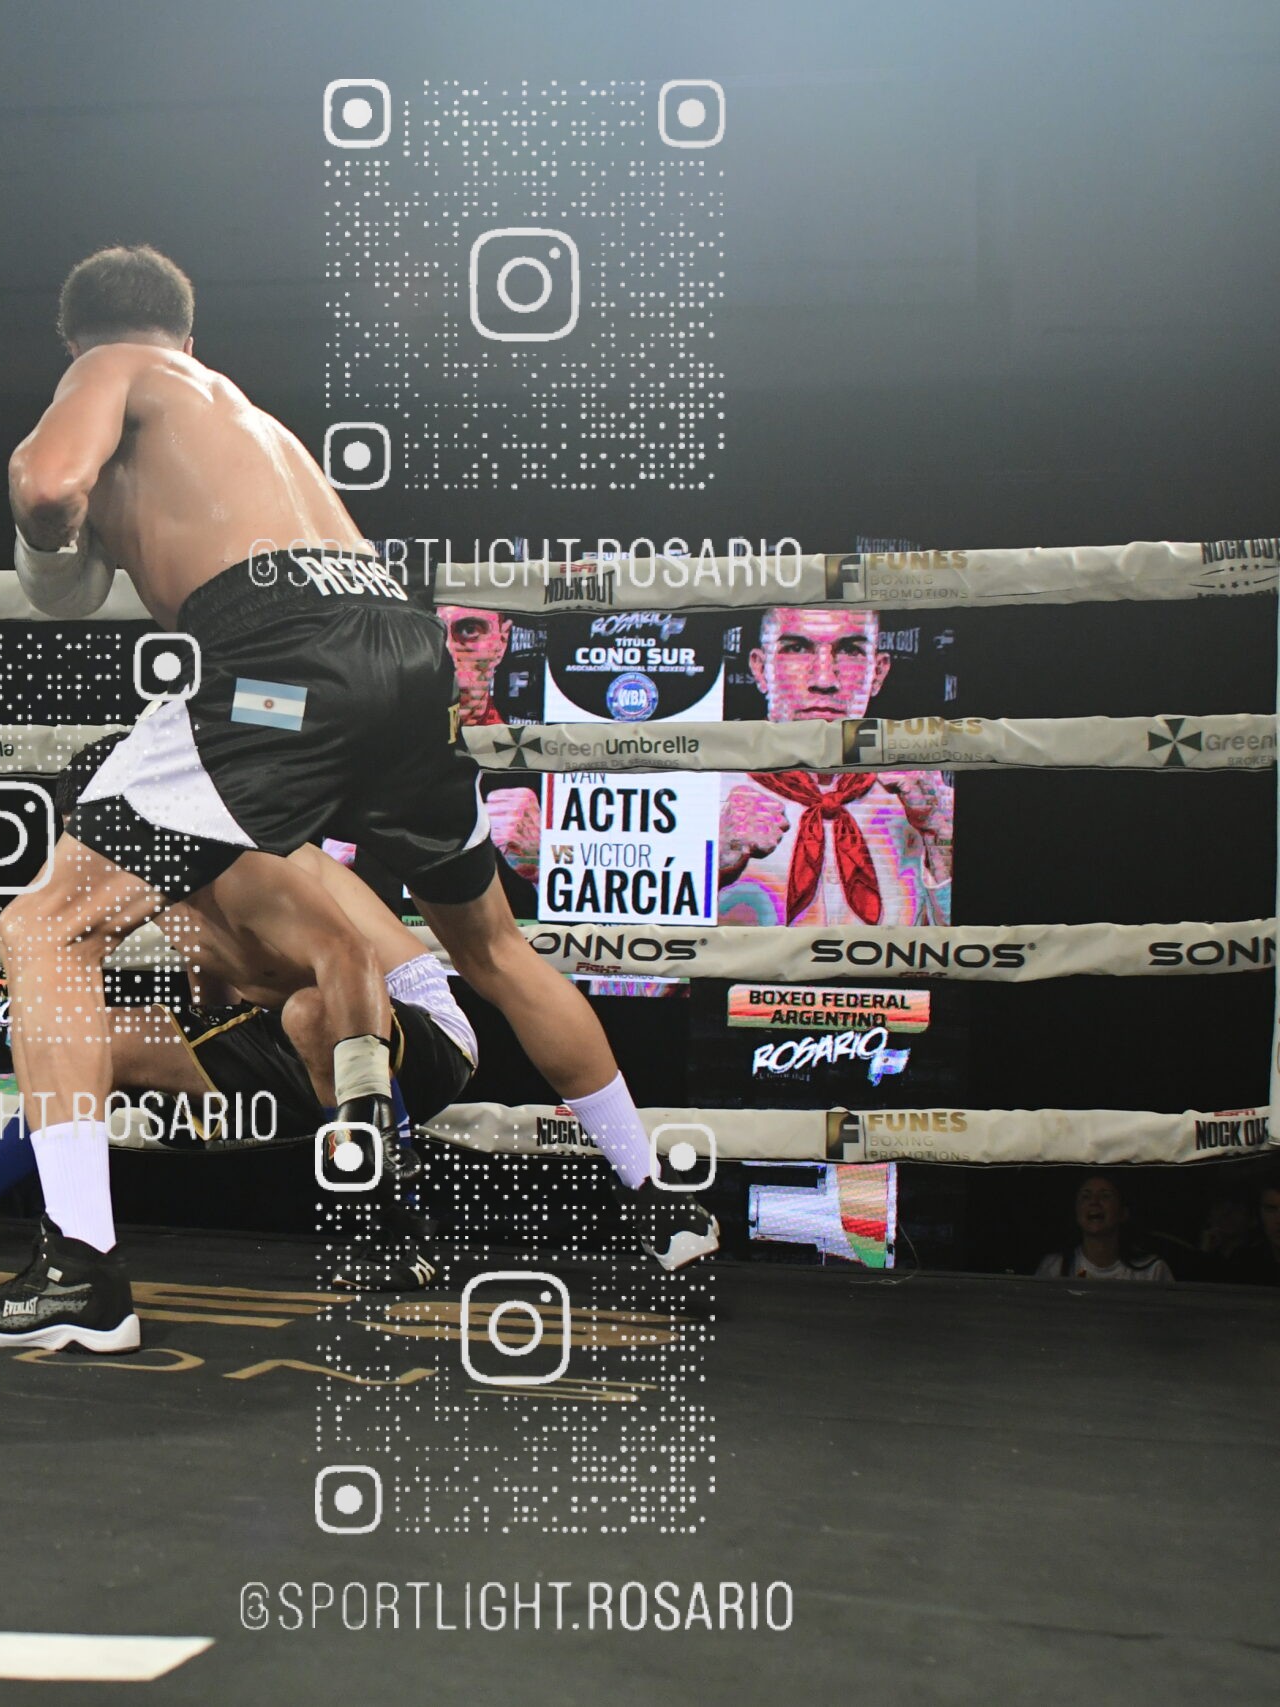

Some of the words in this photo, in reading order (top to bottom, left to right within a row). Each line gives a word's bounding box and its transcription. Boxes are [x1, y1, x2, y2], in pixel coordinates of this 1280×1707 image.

[869, 551, 968, 571] FUNES
[870, 574, 933, 586] BOXING
[575, 647, 641, 665] CONO
[646, 648, 696, 665] SUR
[886, 719, 984, 735] FUNES
[544, 736, 699, 757] GreenUmbrella
[561, 787, 677, 834] ACTIS
[581, 843, 651, 867] VICTOR
[547, 857, 699, 916] GARCÍA
[749, 990, 815, 1006] BOXEO
[822, 993, 911, 1009] FEDERAL
[771, 1010, 886, 1027] ARGENTINO
[752, 1027, 888, 1077] ROSARIO
[868, 1112, 968, 1133] FUNES
[870, 1136, 934, 1147] BOXING
[2, 1297, 39, 1318] EVERLAST
